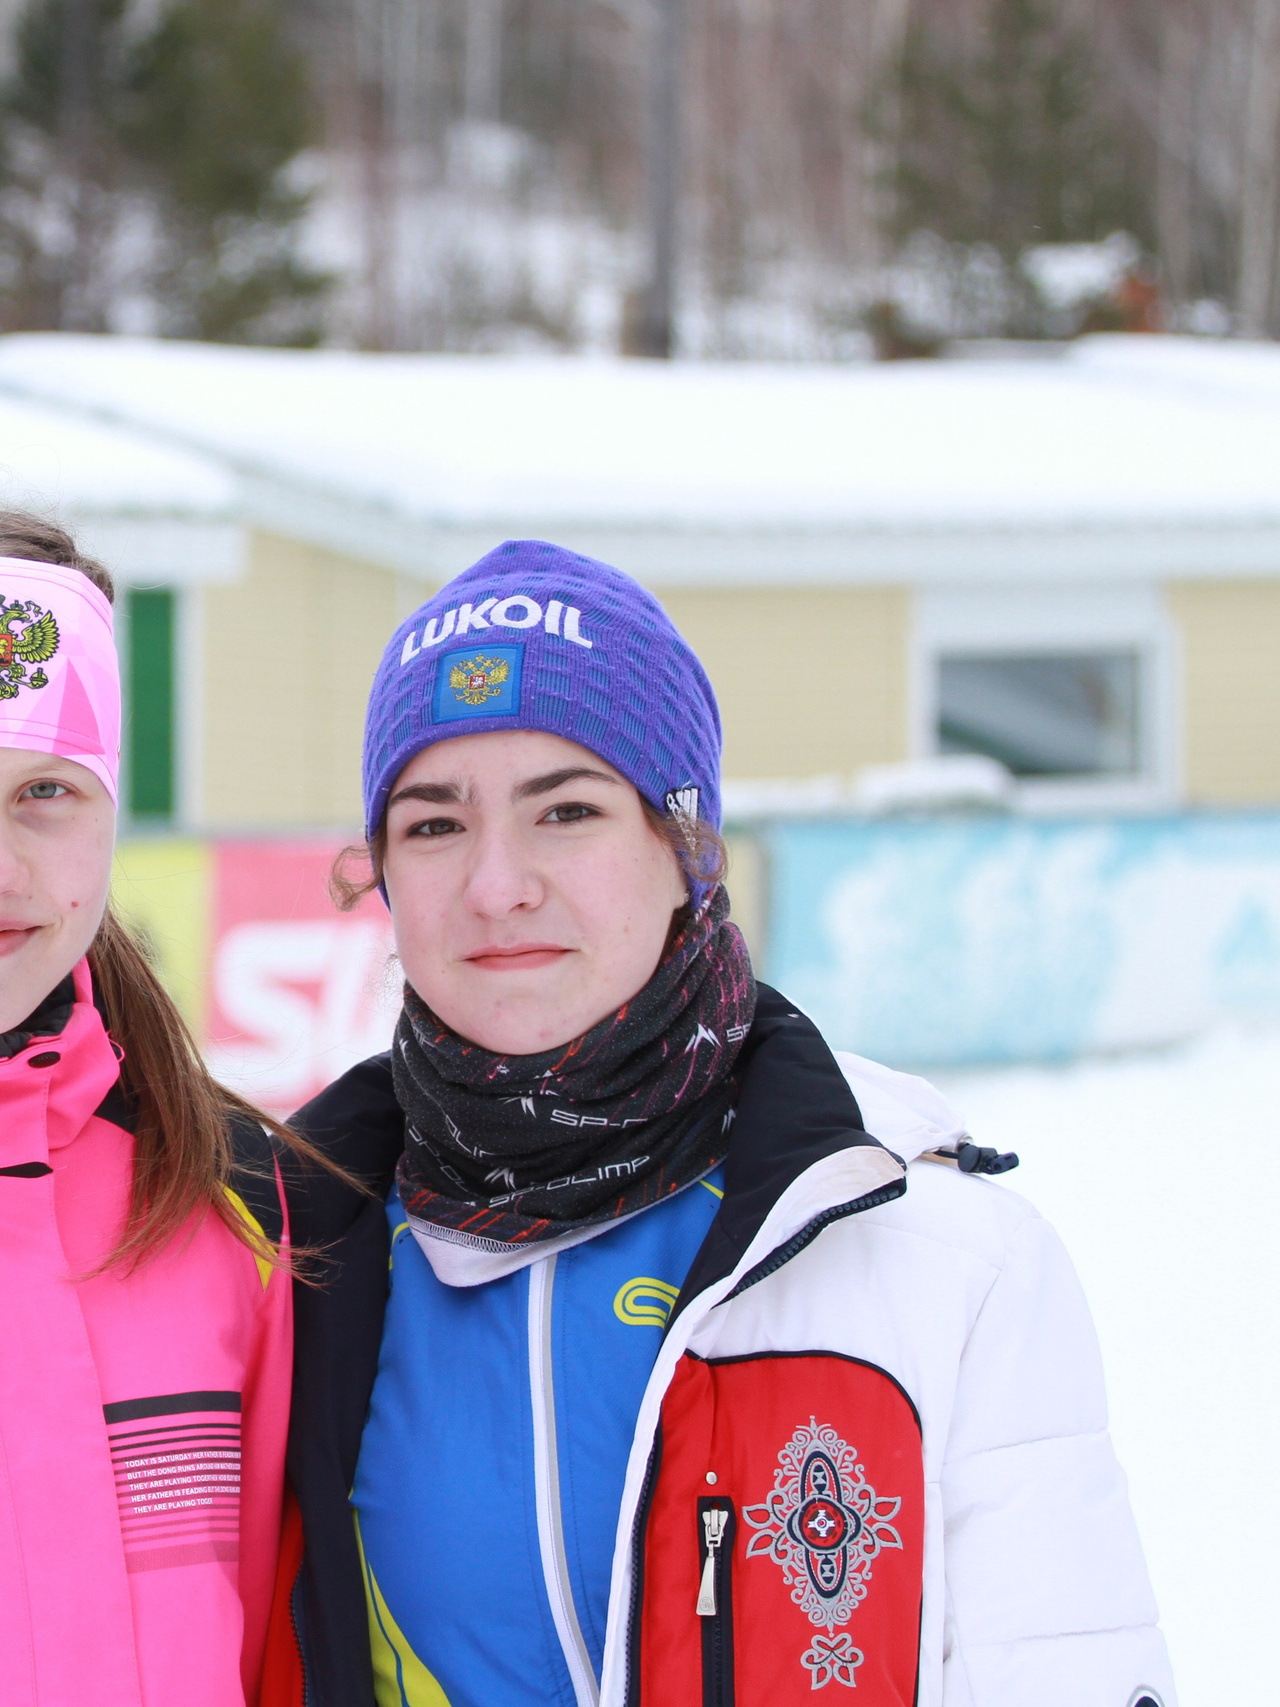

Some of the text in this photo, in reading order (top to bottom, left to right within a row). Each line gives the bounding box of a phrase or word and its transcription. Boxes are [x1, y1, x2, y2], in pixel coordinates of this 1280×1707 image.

[400, 595, 593, 666] LUKOIL
[125, 1459, 149, 1468] TODAY
[150, 1457, 157, 1465] IS
[158, 1452, 192, 1463] SATURDAY
[127, 1471, 142, 1480] BUT
[143, 1469, 156, 1477] THE
[177, 1464, 195, 1473] RUNS
[129, 1482, 149, 1491] THEY
[150, 1479, 163, 1488] ARE
[164, 1476, 192, 1486] PLAYING
[131, 1494, 147, 1503] HER
[148, 1490, 174, 1500] FATHER
[174, 1489, 181, 1497] IS
[133, 1505, 153, 1514] THEY
[154, 1502, 167, 1511] ARE
[168, 1499, 196, 1509] PLAYING
